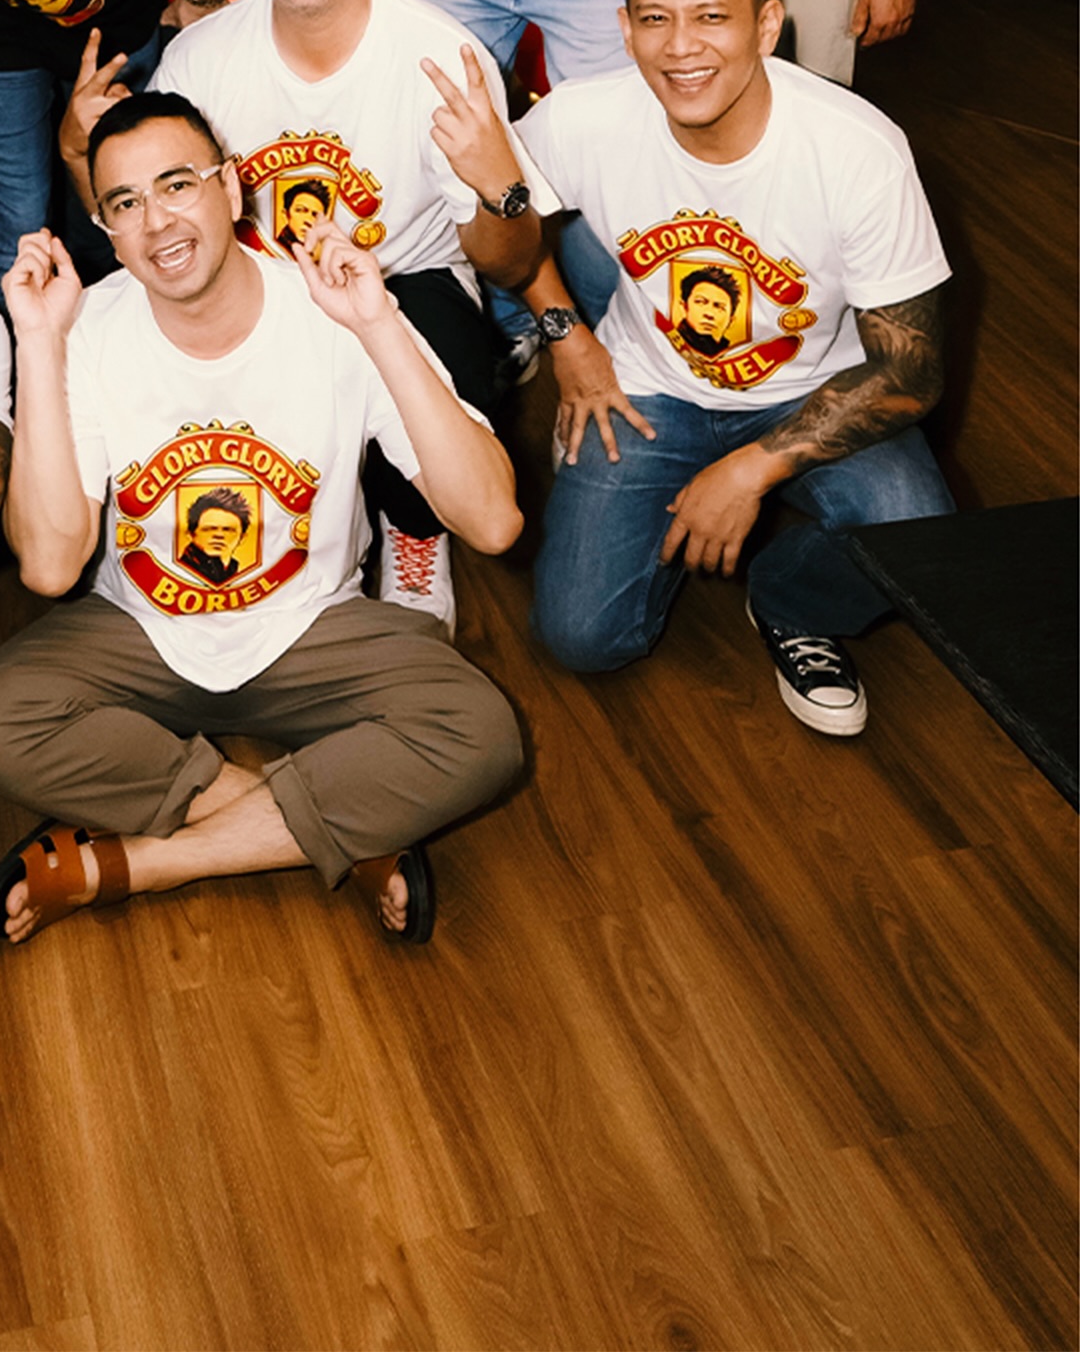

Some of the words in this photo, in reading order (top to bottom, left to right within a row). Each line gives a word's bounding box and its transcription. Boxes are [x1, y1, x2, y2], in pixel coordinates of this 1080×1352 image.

[239, 145, 310, 185] GLORY
[633, 224, 709, 267] GLORY
[713, 227, 791, 297] GLORY!
[135, 438, 214, 505] GLORY
[219, 439, 307, 506] GLORY!
[151, 576, 280, 615] BORIEL
